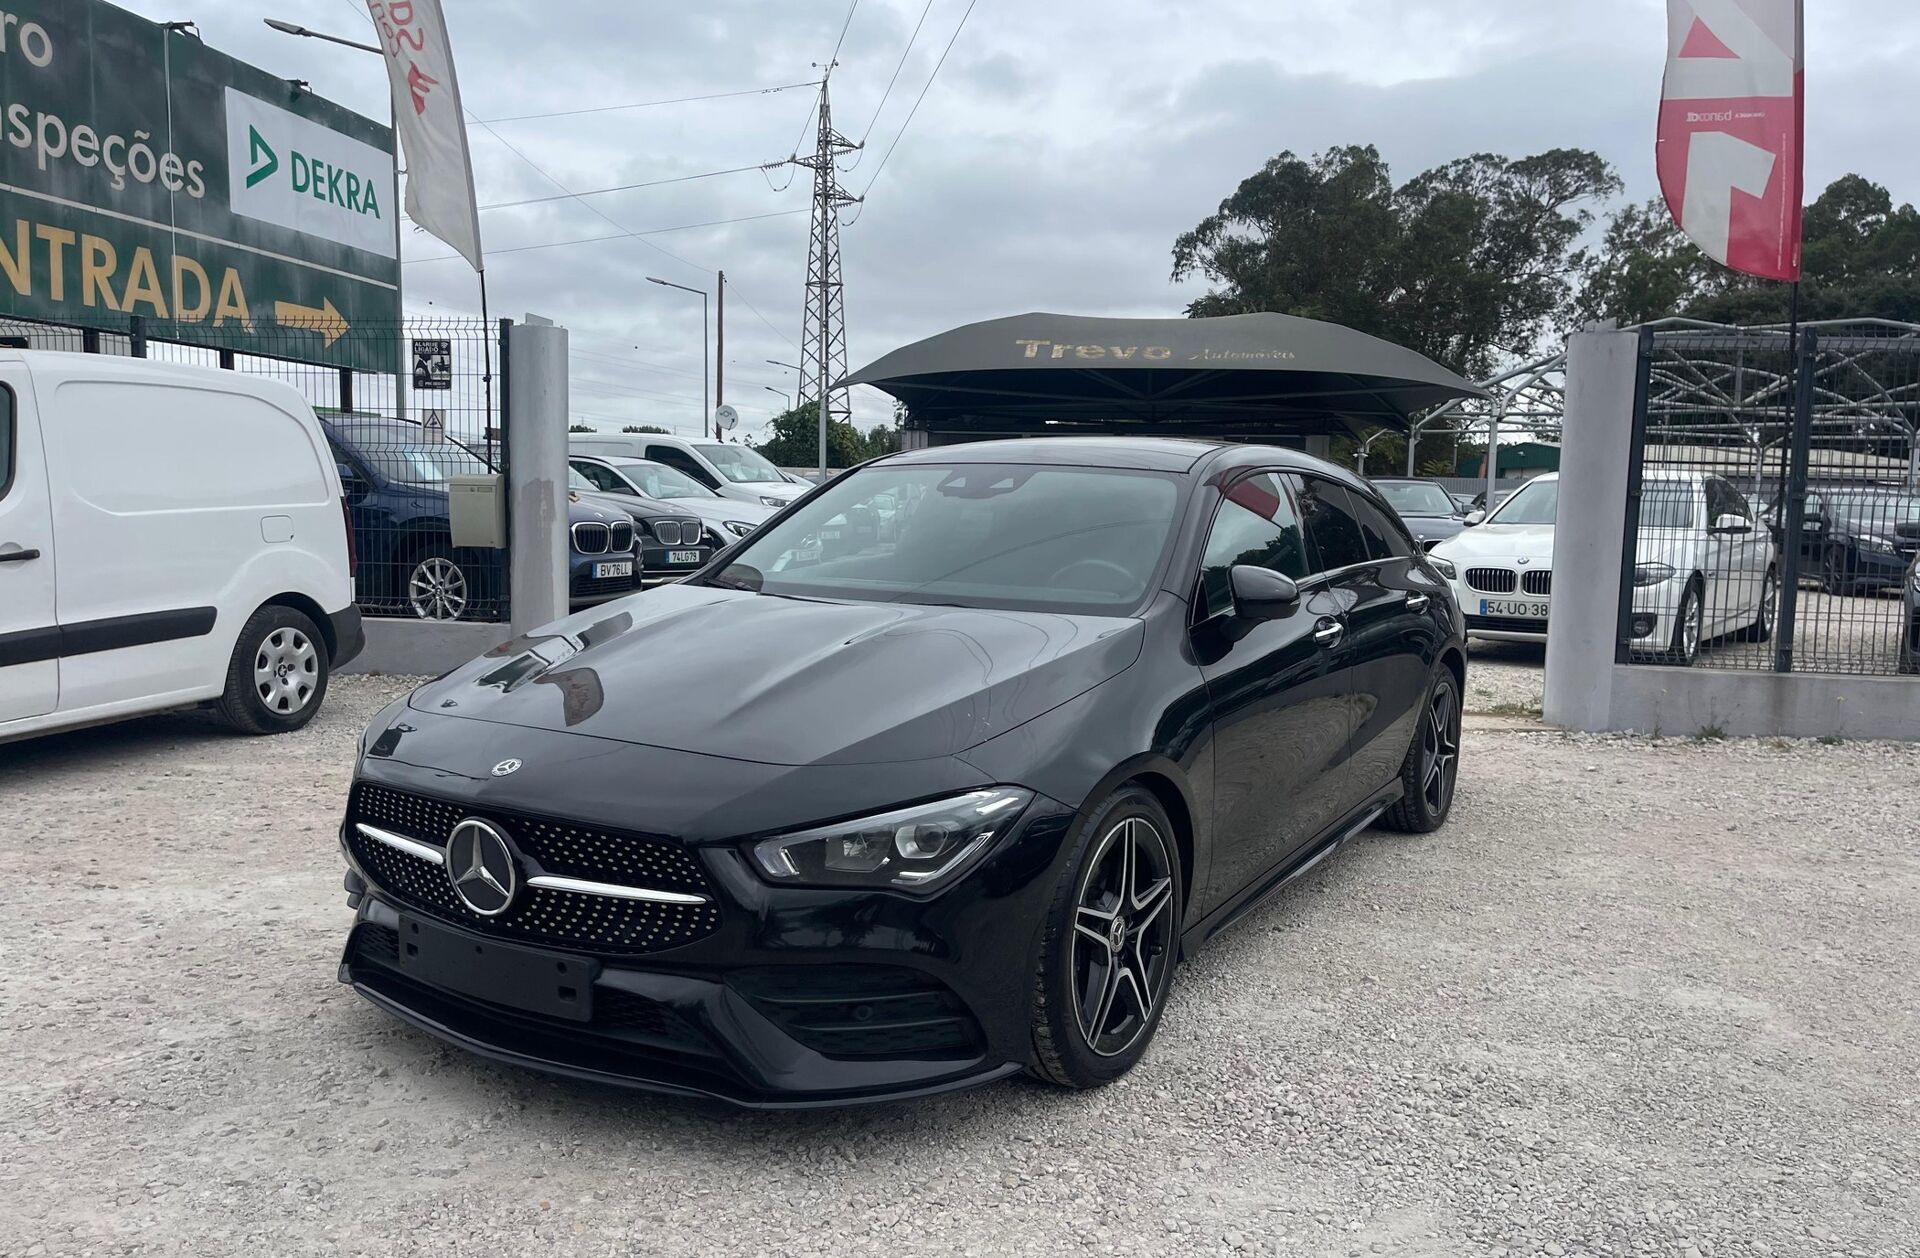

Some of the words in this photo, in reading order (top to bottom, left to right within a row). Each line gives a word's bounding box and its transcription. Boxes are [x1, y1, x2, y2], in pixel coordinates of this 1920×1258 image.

[0, 103, 205, 199] speções
[291, 150, 381, 219] DEKRA
[1016, 339, 1171, 359] Trevo
[600, 563, 629, 576] BV76LL
